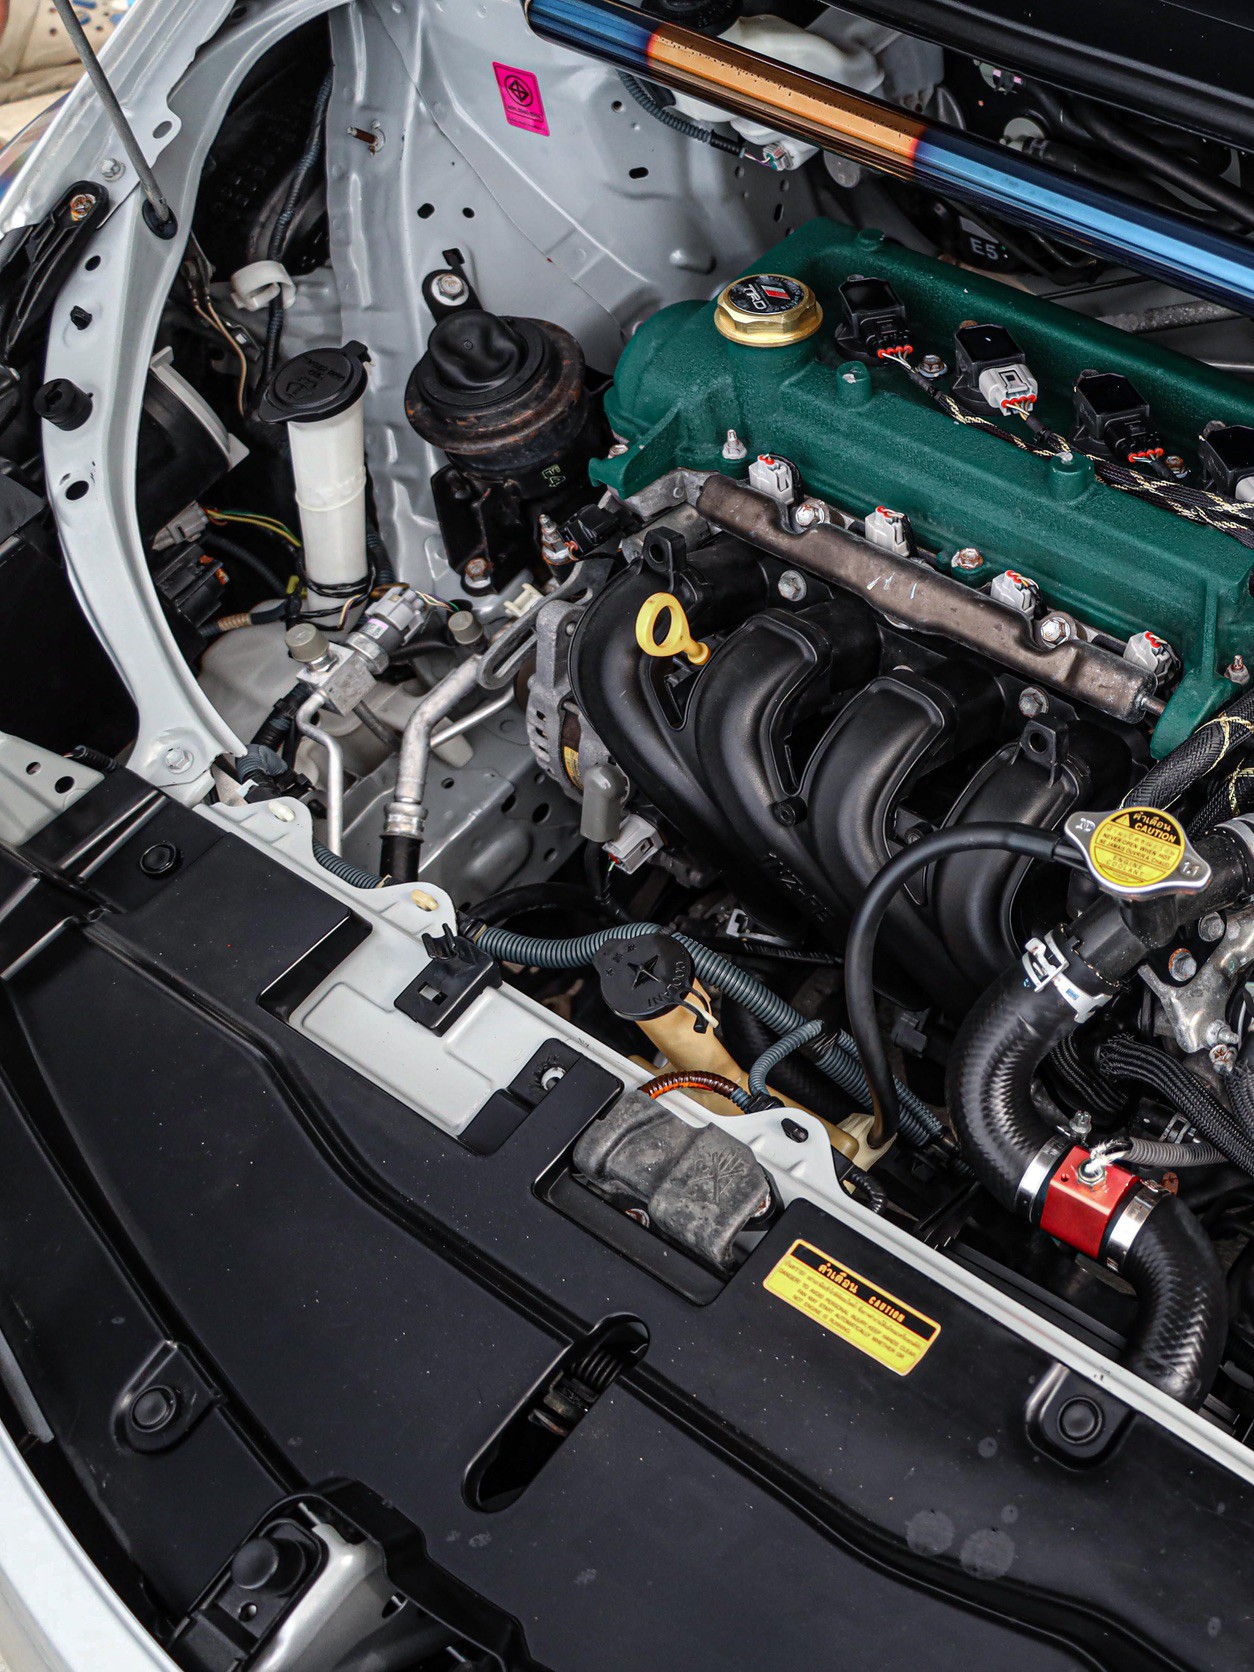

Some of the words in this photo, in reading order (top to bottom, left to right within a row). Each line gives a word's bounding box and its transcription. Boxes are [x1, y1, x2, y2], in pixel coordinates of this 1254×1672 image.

[969, 237, 999, 261] E5
[743, 283, 767, 310] TRD
[1134, 823, 1177, 843] CAUTION
[1103, 833, 1122, 843] NEVER
[1122, 840, 1138, 849] OPEN
[1139, 846, 1156, 856] WHEN
[1158, 853, 1171, 861] HOT
[1106, 841, 1126, 852] JAMAIS
[1151, 858, 1170, 868] CHAUD
[1106, 859, 1144, 877] COOLANT
[1112, 855, 1143, 870] ENGINE
[1182, 861, 1200, 877] 1.1
[792, 1294, 803, 1304] NOT
[803, 1301, 822, 1315] ENGINE
[867, 1296, 906, 1323] CAUTION
[796, 1289, 807, 1298] FAN
[807, 1295, 818, 1305] MAY
[818, 1303, 834, 1315] START
[834, 1312, 871, 1338] AUTOMATICALLY
[871, 1336, 896, 1354] WHETHER
[896, 1351, 905, 1359] OR
[809, 1288, 824, 1299] AVOID
[824, 1297, 850, 1315] PERSONAL
[881, 1334, 899, 1347] HANDS
